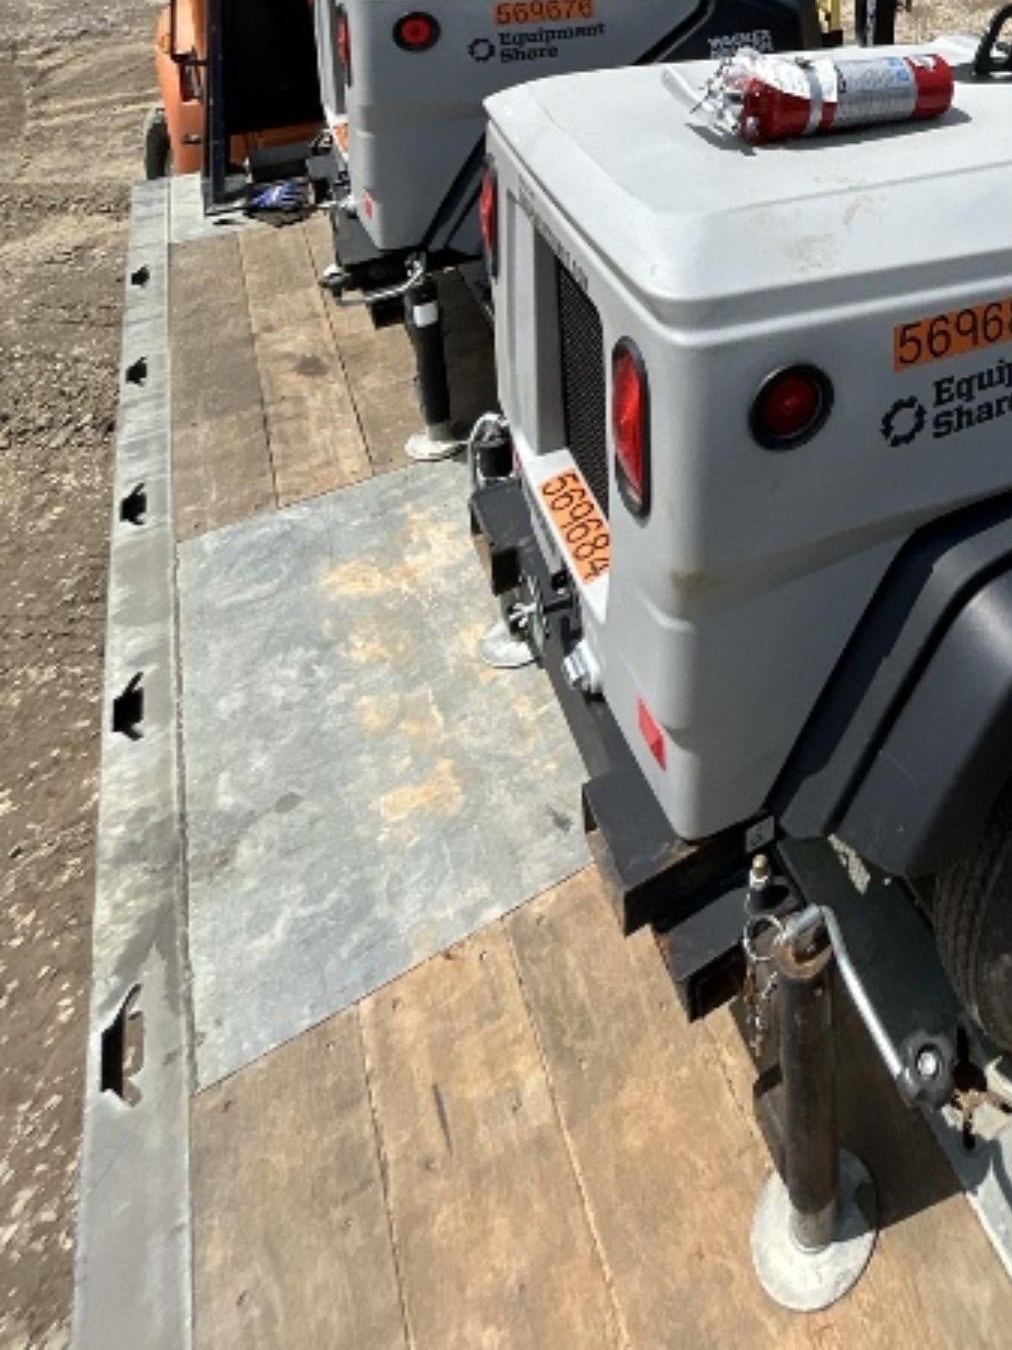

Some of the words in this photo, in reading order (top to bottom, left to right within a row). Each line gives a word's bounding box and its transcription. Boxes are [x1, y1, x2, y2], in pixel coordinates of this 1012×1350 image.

[498, 23, 606, 48] Equipment
[500, 47, 558, 63] Share
[542, 472, 609, 580] 569684
